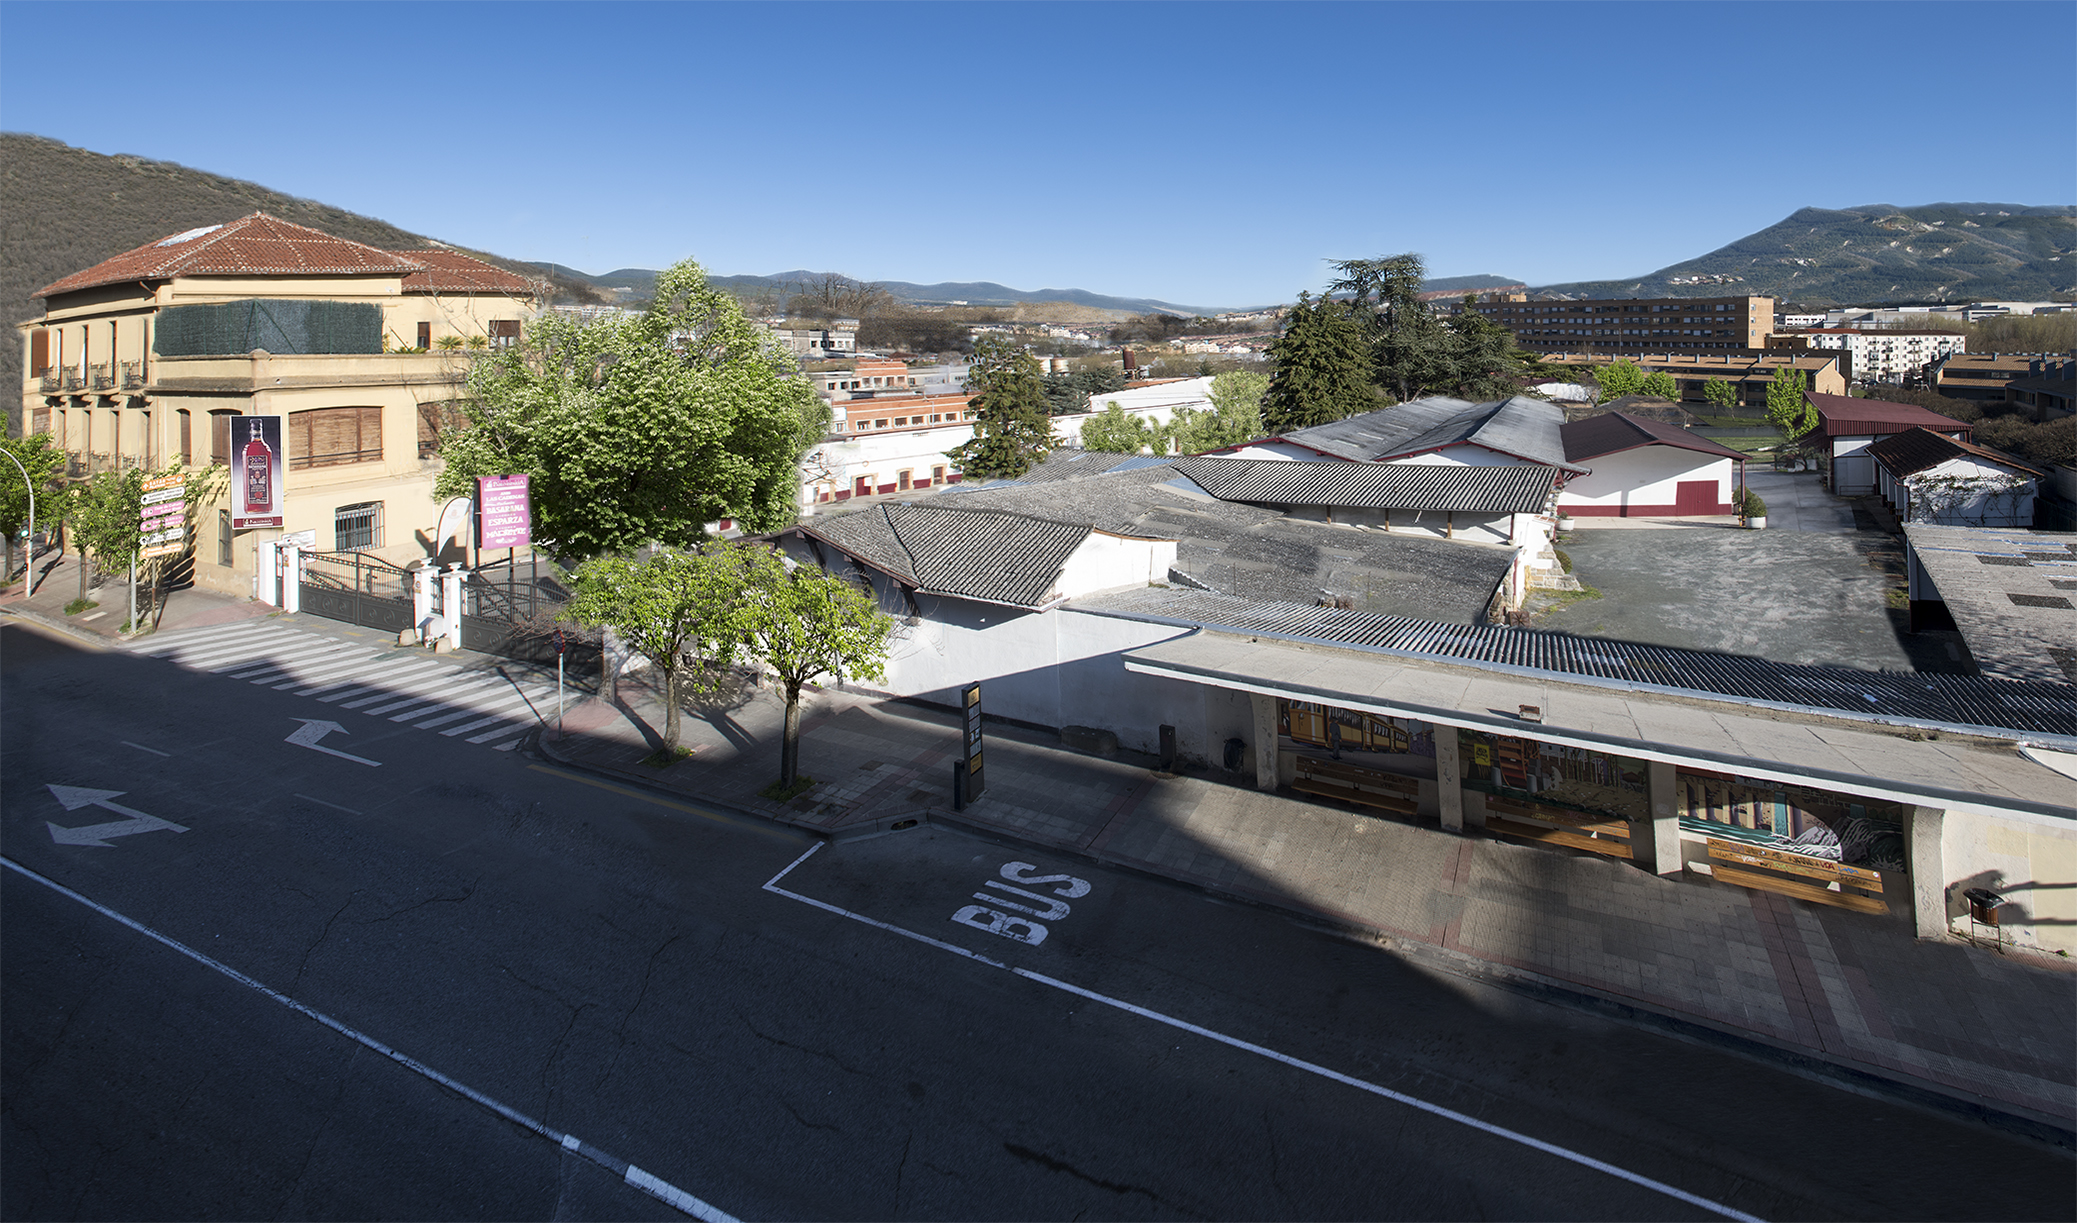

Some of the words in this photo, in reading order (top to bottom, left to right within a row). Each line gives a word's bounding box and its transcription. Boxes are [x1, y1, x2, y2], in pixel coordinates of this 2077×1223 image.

[486, 504, 525, 514] BASARANA
[487, 516, 524, 526] ESPARZA
[951, 861, 1091, 946] BUS
